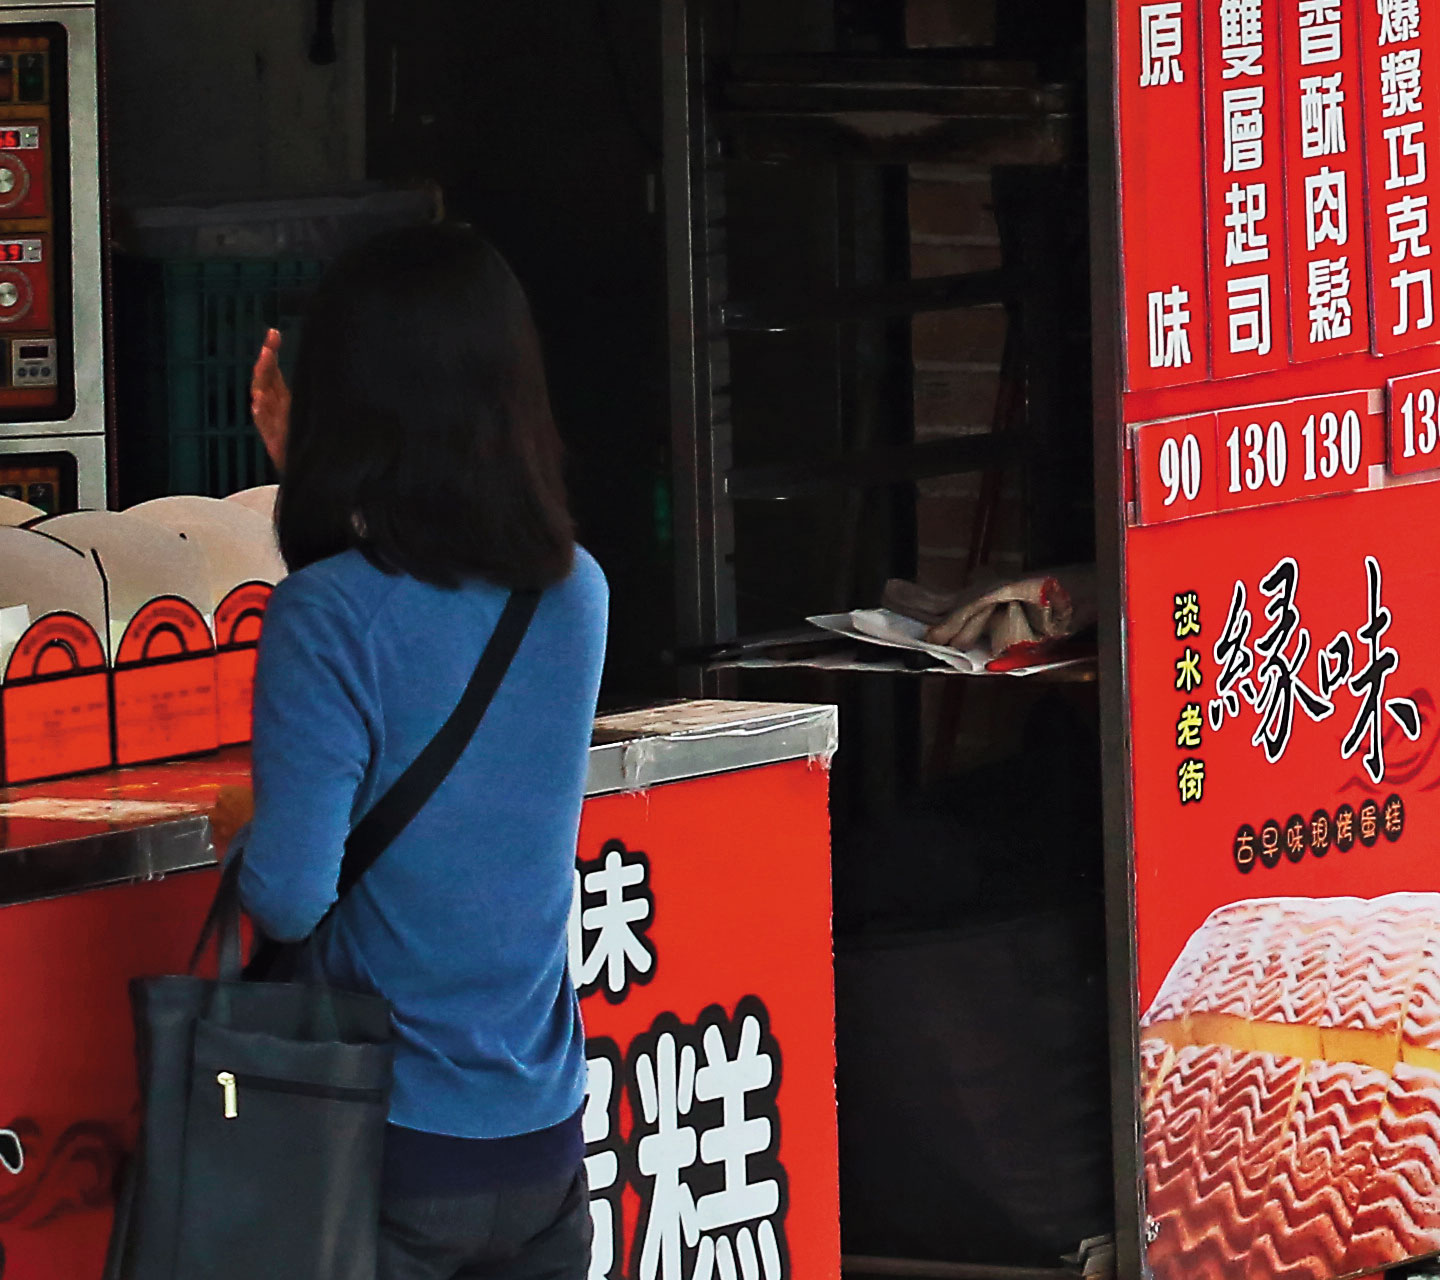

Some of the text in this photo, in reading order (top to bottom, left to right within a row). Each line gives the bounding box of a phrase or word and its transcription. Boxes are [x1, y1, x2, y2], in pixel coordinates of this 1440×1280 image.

[1139, 2, 1193, 368] 原味
[1159, 434, 1201, 507] 90
[1226, 421, 1287, 494] 130
[1301, 409, 1361, 481] 130
[1174, 593, 1204, 803] 淡水老街
[1236, 800, 1403, 867] 古早味現烤蛋糕
